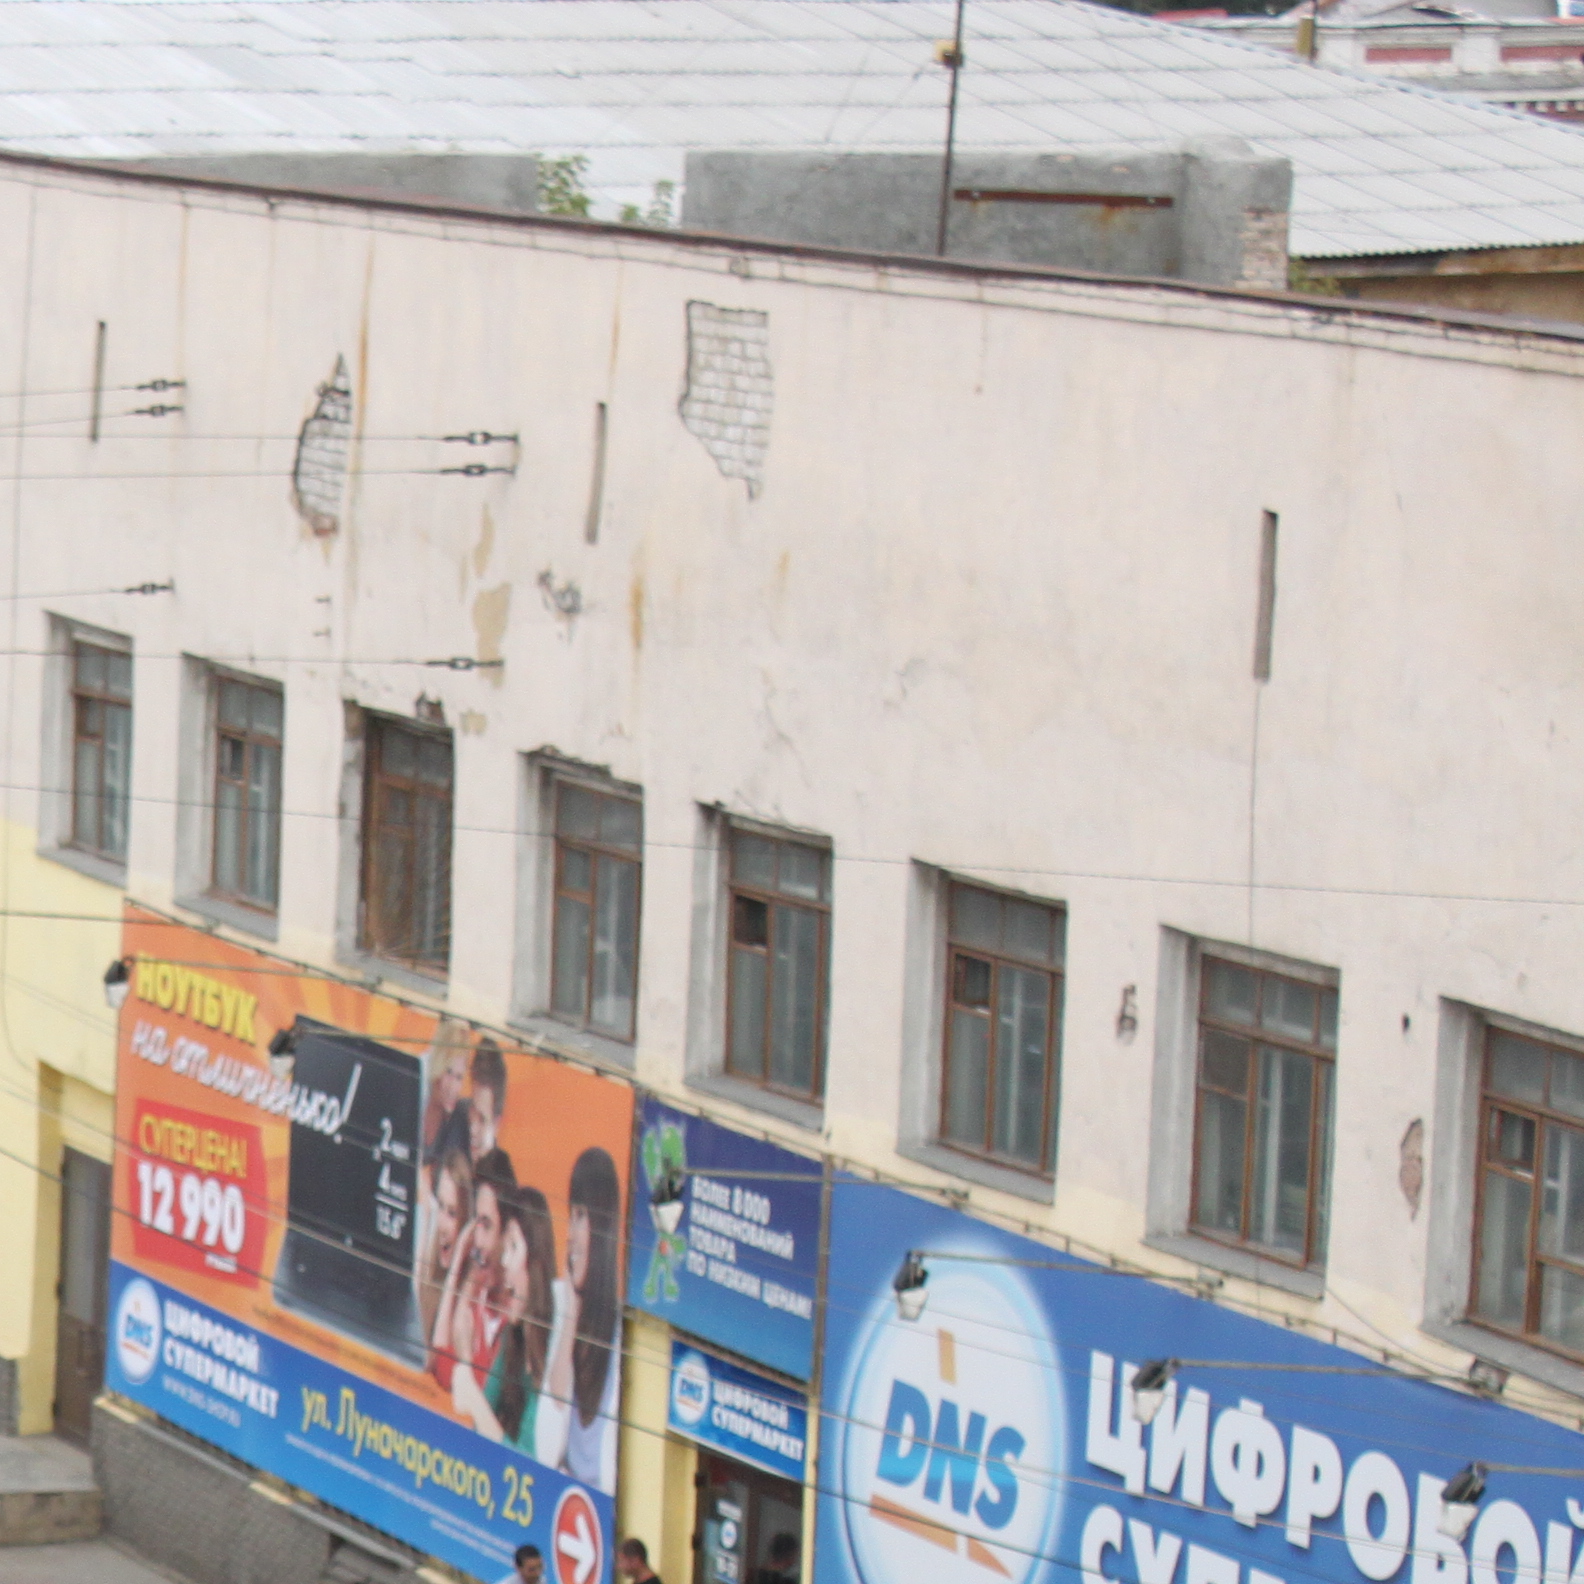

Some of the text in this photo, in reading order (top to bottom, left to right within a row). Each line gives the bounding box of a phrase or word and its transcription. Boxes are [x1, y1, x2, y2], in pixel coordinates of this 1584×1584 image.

[136, 950, 257, 1046] НОУТБУК
[179, 1172, 246, 1254] 990
[163, 1299, 261, 1374] ЦИФРОВОЙ
[163, 1336, 280, 1419] СУПЕРМАРКЕТ
[712, 1404, 805, 1462] СУПЕРМАРКЕТ
[713, 1379, 790, 1432] ЦИФРОВОЙ
[301, 1386, 333, 1433] ул.
[502, 1464, 535, 1528] 25
[876, 1377, 1027, 1532] DNS
